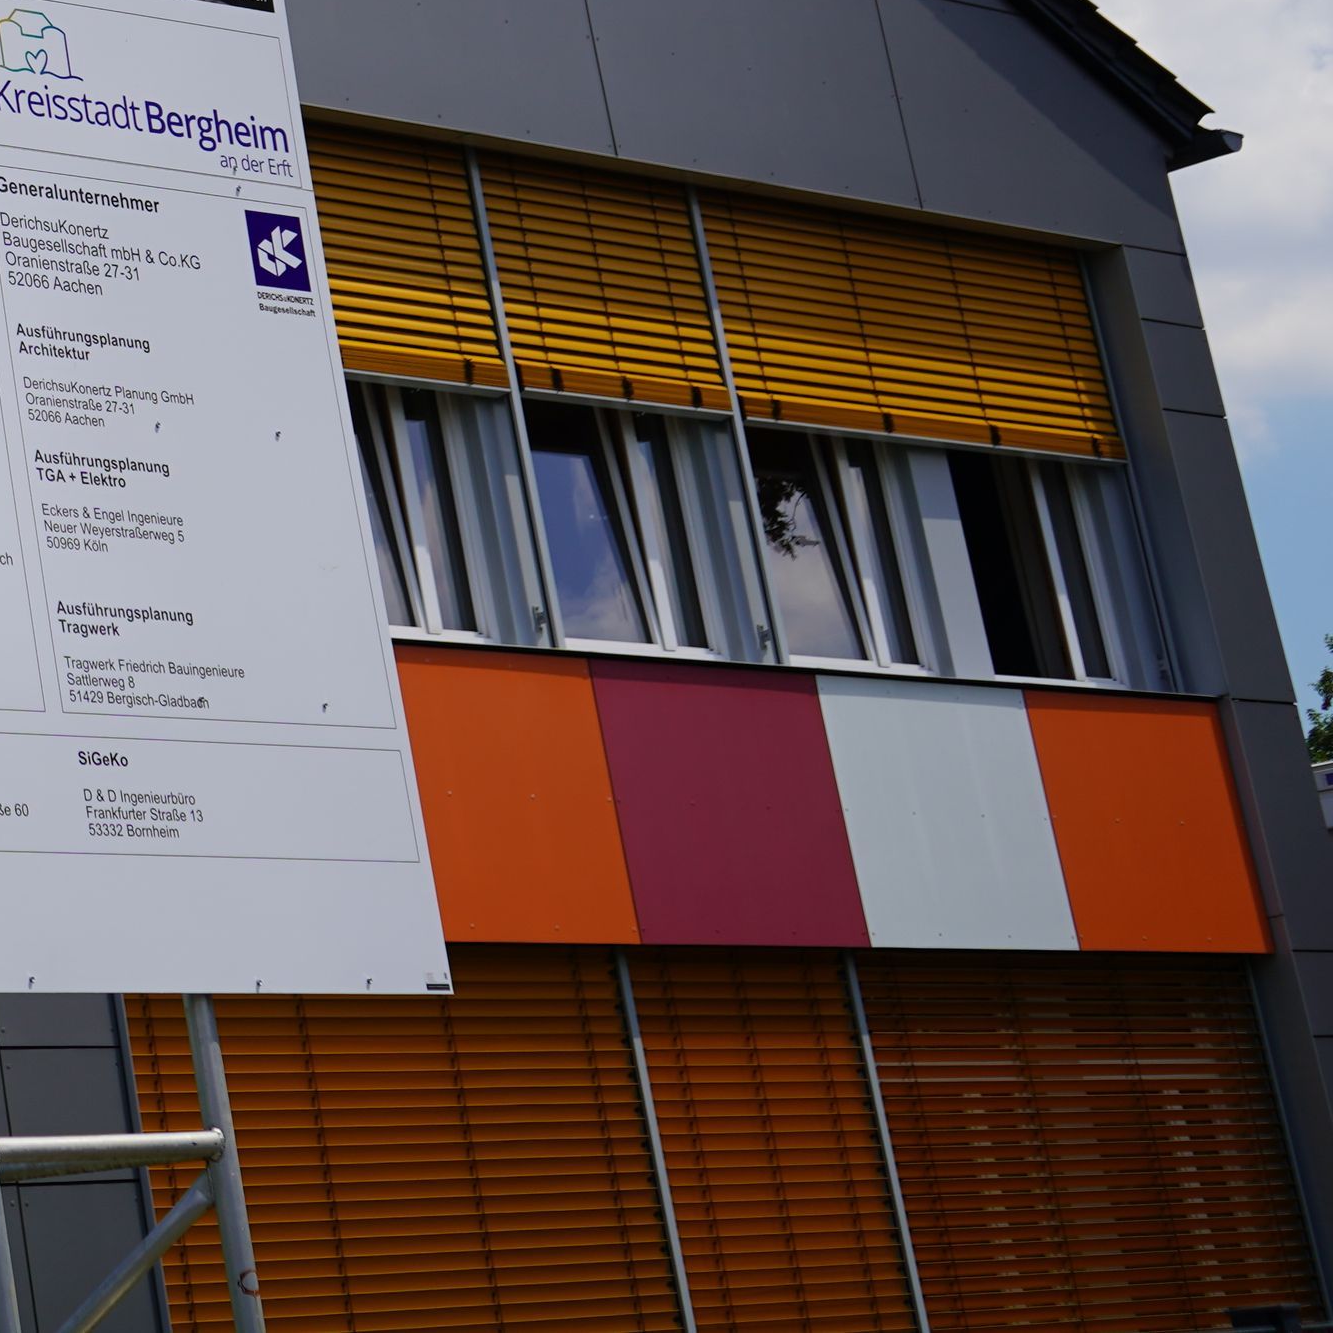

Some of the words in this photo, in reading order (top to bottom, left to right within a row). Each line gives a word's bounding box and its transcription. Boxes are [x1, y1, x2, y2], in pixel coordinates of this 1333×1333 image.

[144, 100, 290, 153] Bergheim
[241, 154, 265, 173] der
[267, 158, 294, 178] Erft
[0, 211, 110, 240] DerichsuKonertz
[2, 231, 108, 259] Baugesellschaft
[110, 246, 142, 263] mbH
[158, 251, 201, 270] Co.KG
[5, 251, 100, 277] Oranienstraße
[103, 262, 140, 281] 27-31
[8, 270, 50, 290] 52066
[53, 276, 103, 296] Aachen
[16, 323, 151, 353] Ausführungsplanung
[19, 340, 90, 361] Architektur
[23, 376, 112, 401] DerichsuKonertz
[114, 385, 158, 405] Planung
[160, 390, 195, 405] GmbH
[25, 392, 103, 412] Oranienstraße
[105, 400, 135, 415] 27-31
[28, 408, 62, 423] 52066
[64, 412, 105, 427] Aachen
[34, 449, 170, 478] Ausführungsplanung
[35, 467, 66, 483] TGA
[80, 471, 126, 488] Elektro
[41, 503, 80, 518] Eckers
[93, 507, 125, 524] Engel
[127, 510, 184, 527] Ingenieure
[43, 519, 77, 534] Neuer
[79, 522, 175, 545] Weyerstraßerweg
[177, 529, 185, 543] 5
[46, 535, 81, 551] 50969
[83, 538, 109, 553] Köln
[56, 600, 194, 627] Ausführungsplanung
[58, 618, 120, 638] Tragwerk
[63, 655, 116, 673] Tragwerk
[118, 659, 166, 674] Friedrich
[168, 661, 245, 679] Bauingenieure
[66, 672, 125, 692] Sattlerweg
[127, 676, 136, 689] 8
[69, 689, 104, 704] 51429
[77, 750, 129, 767] SiGeKo
[119, 790, 196, 806] Ingenieurbüro
[14, 803, 29, 817] 60
[85, 805, 147, 821] Frankfurter
[149, 807, 187, 822] Straße
[190, 809, 204, 822] 13
[88, 822, 124, 837] 53332
[126, 824, 180, 838] Bornheim
